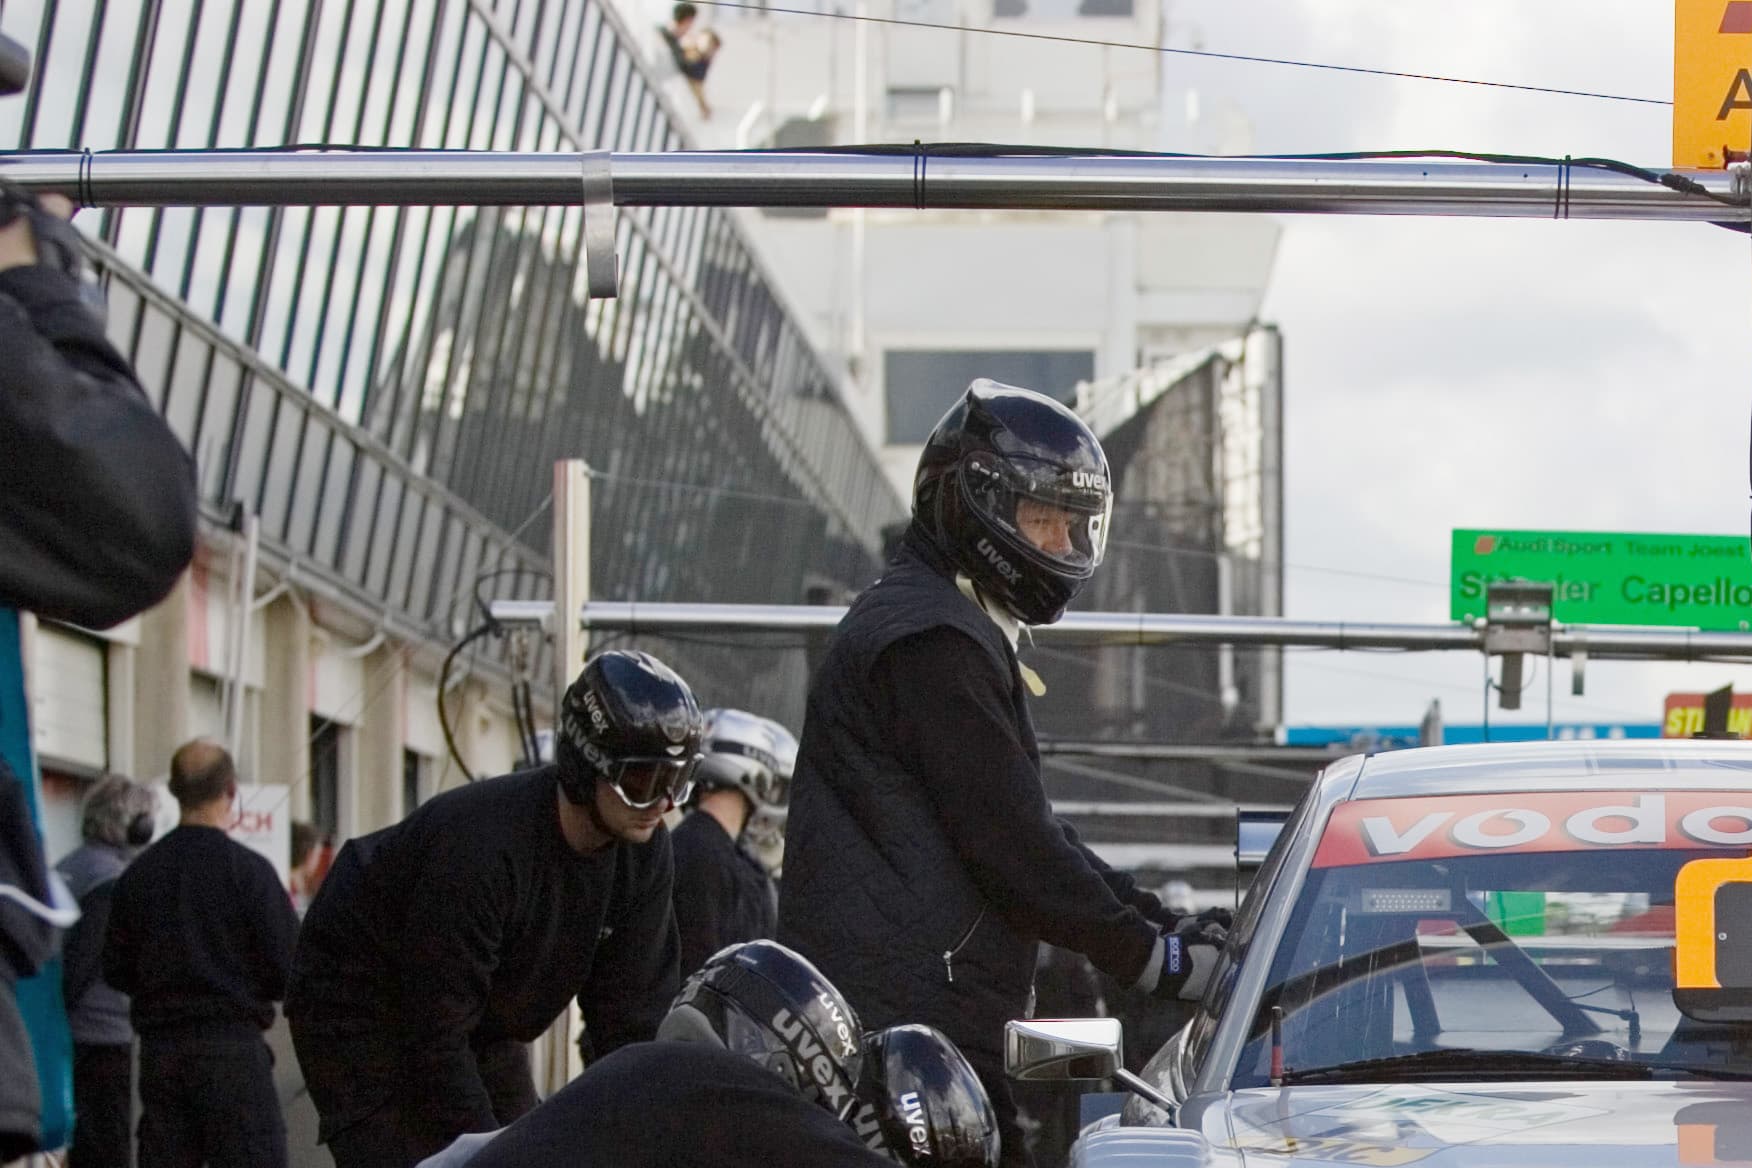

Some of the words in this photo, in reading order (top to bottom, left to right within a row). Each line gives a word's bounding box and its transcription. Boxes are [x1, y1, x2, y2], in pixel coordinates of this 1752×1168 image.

[976, 536, 1023, 584] uvex
[583, 689, 610, 735] uvex
[565, 713, 613, 777] uvex
[818, 991, 858, 1058] uvex
[772, 1007, 849, 1113] uvex
[901, 1091, 932, 1159] uvex
